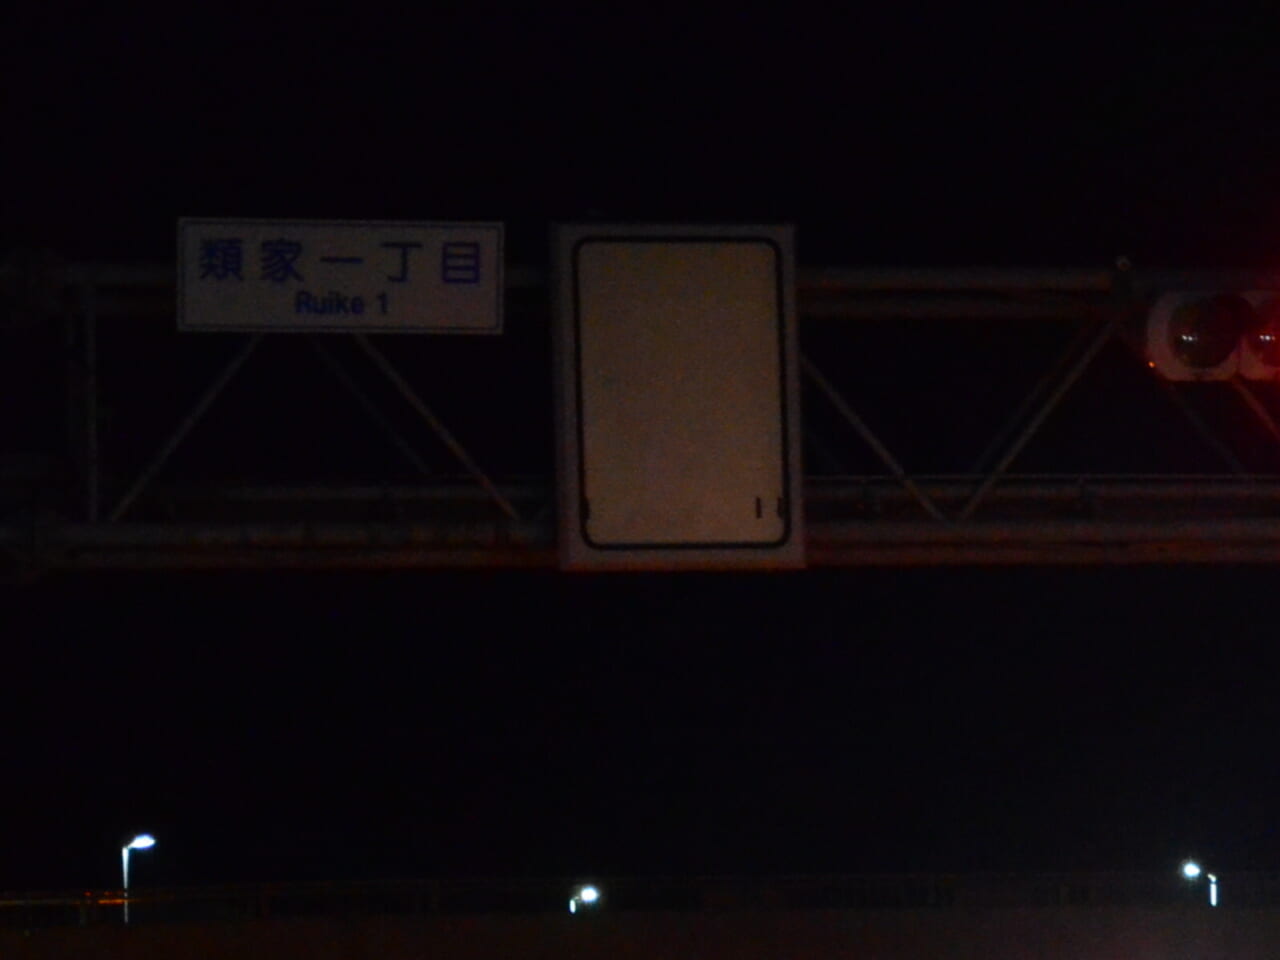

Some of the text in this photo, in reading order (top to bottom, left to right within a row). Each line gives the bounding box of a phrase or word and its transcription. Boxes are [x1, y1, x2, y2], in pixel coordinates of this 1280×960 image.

[200, 238, 480, 284] 類家一丁目
[295, 290, 388, 314] Ruike 1
